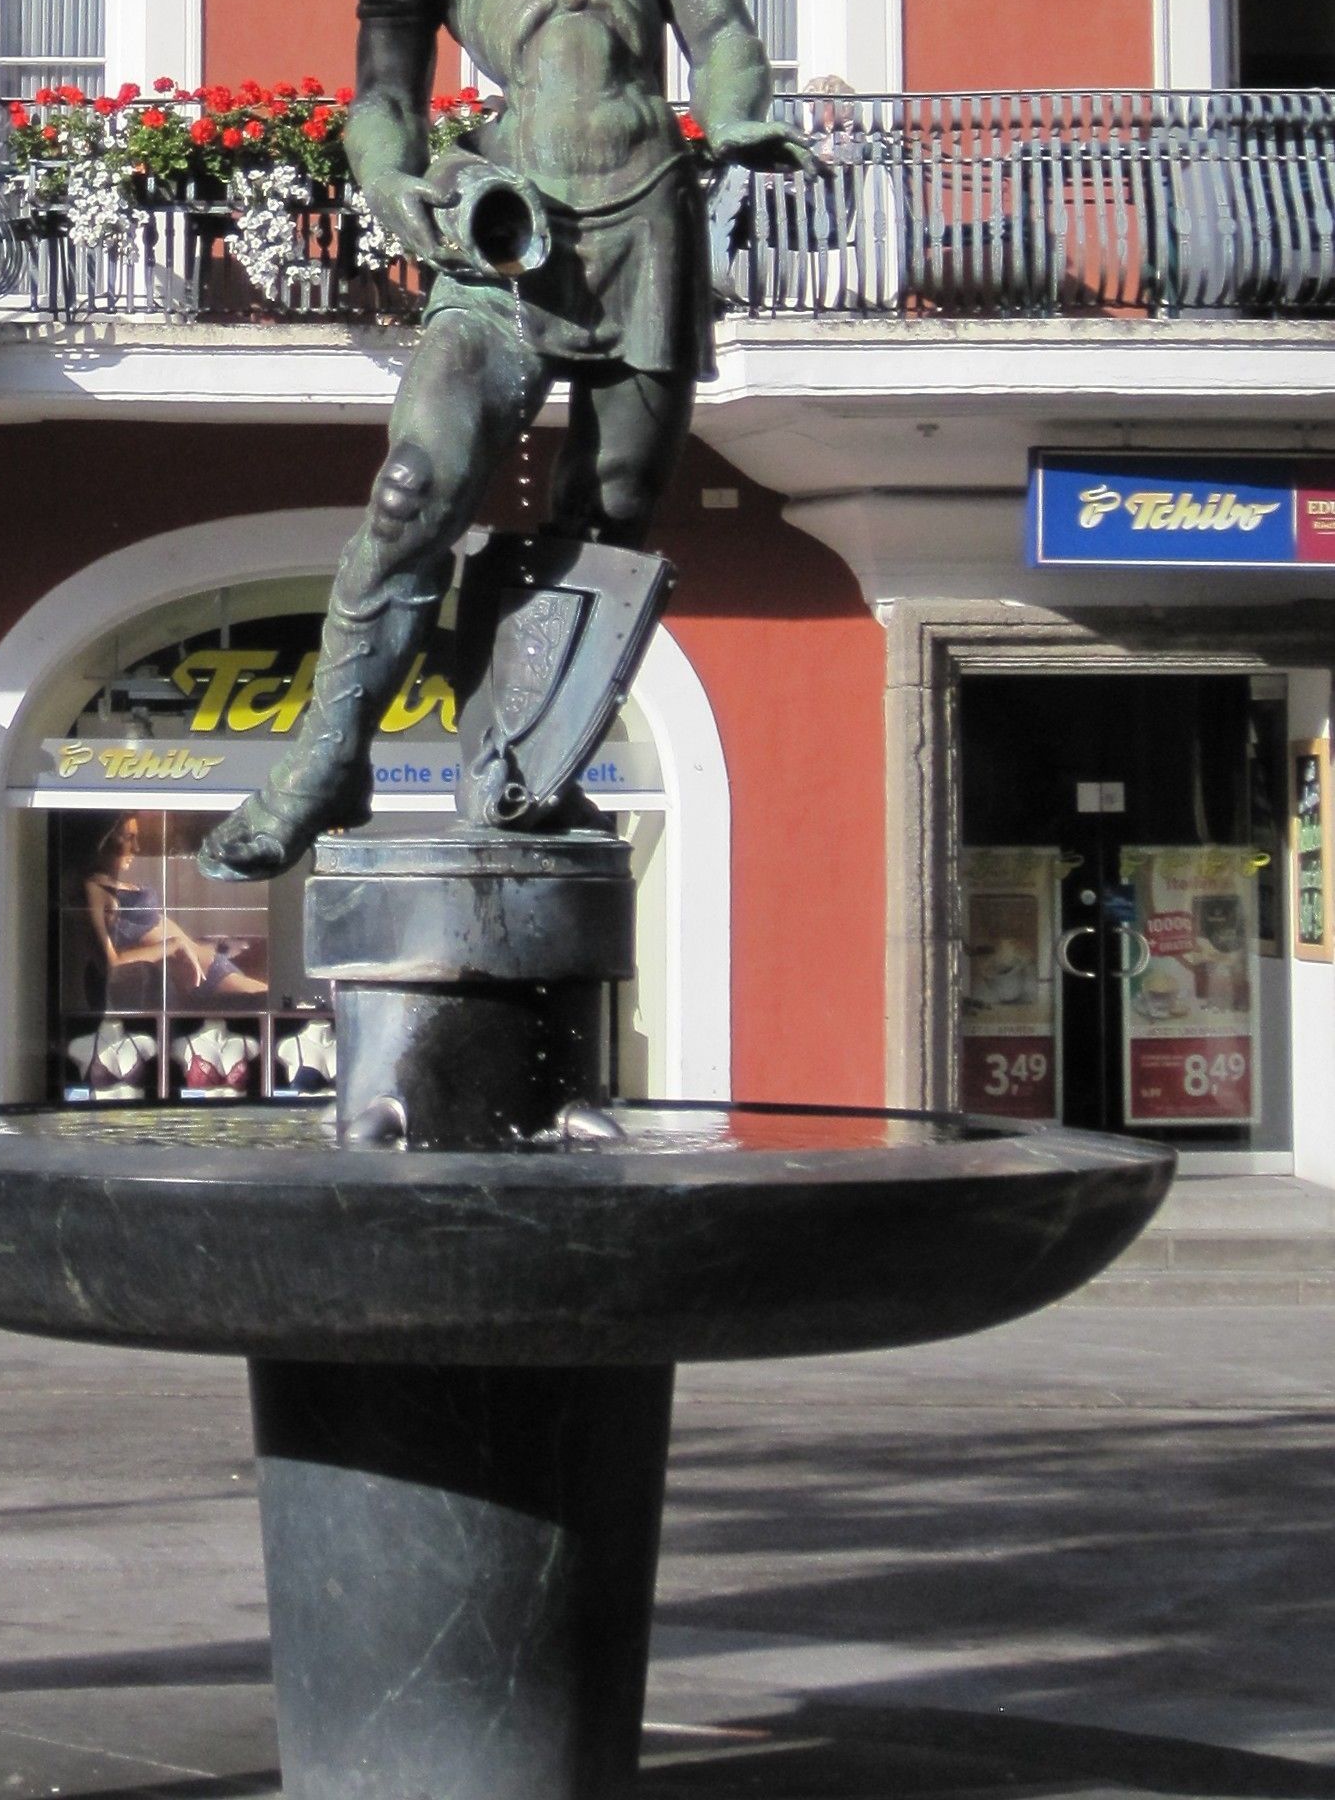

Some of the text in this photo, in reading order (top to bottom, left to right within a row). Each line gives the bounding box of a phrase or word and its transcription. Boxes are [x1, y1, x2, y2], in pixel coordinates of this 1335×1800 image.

[1125, 493, 1280, 531] Tchibo
[98, 749, 226, 780] Tchibo
[368, 764, 432, 783] oche
[578, 763, 625, 782] elt.
